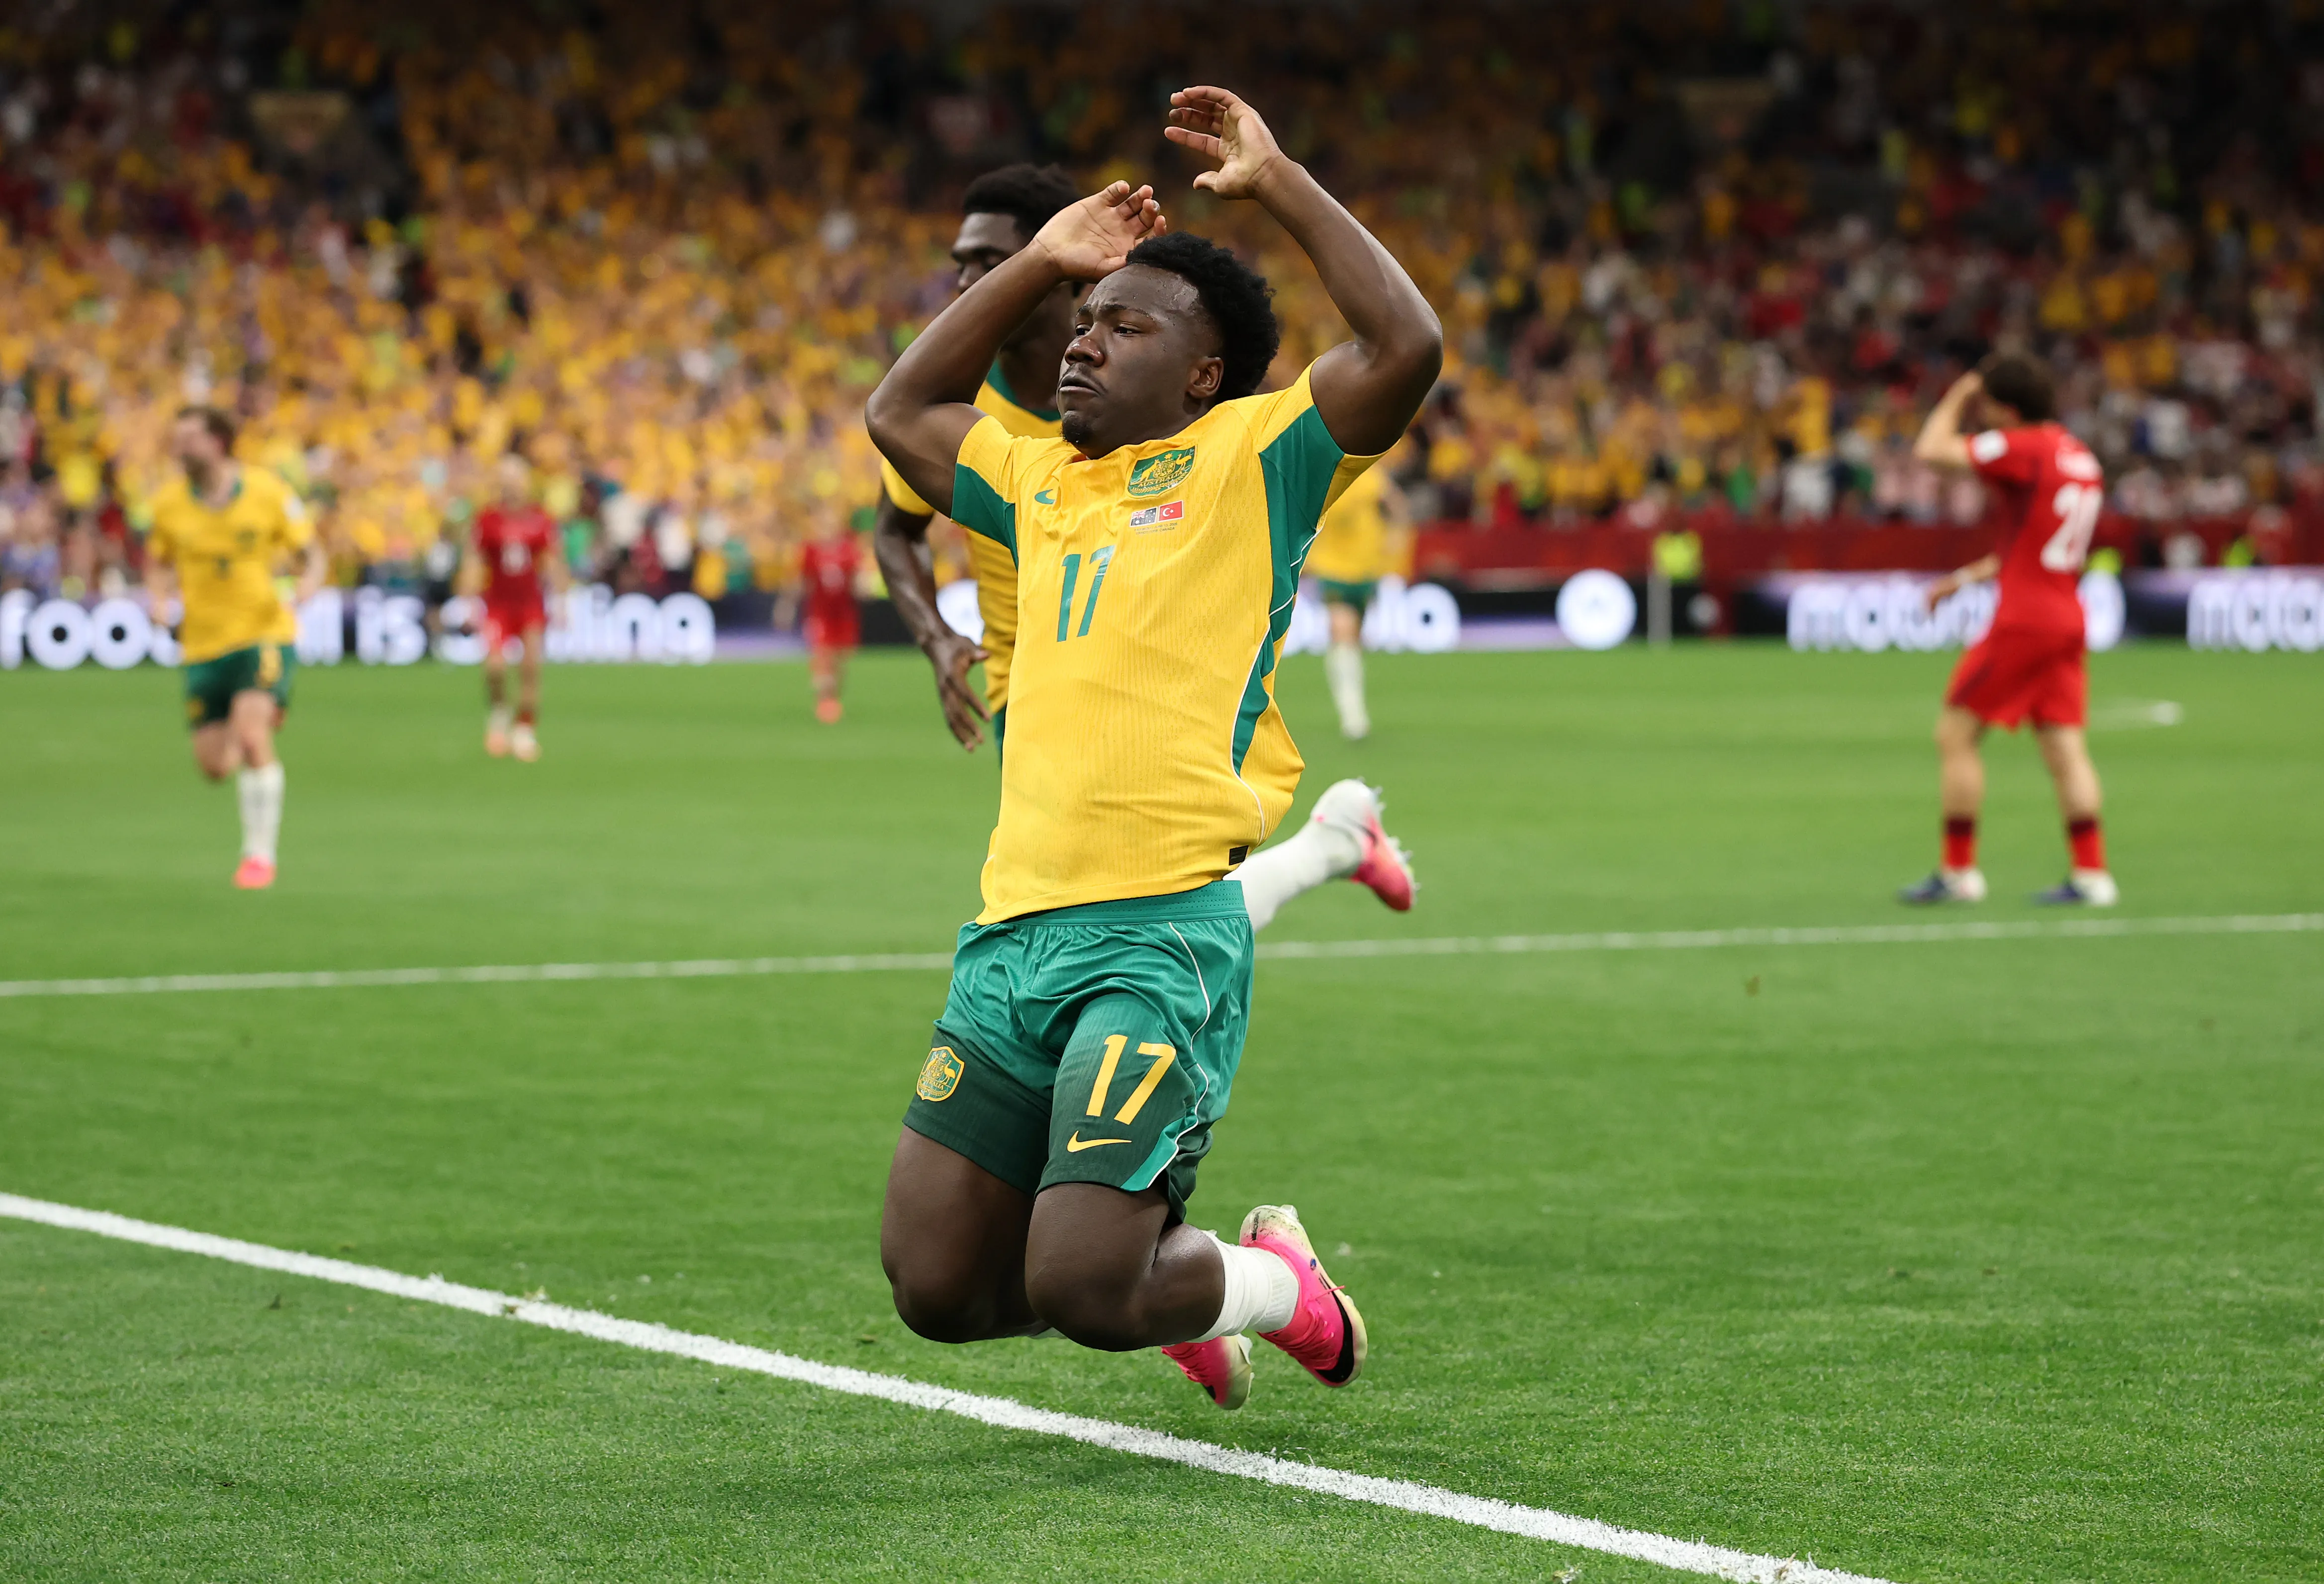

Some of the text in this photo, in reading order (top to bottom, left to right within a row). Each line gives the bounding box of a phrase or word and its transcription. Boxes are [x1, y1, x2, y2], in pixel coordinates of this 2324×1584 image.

[1137, 470, 1183, 488] AUSTRALIA
[1056, 545, 1116, 643] 17
[1086, 1033, 1177, 1125] 17
